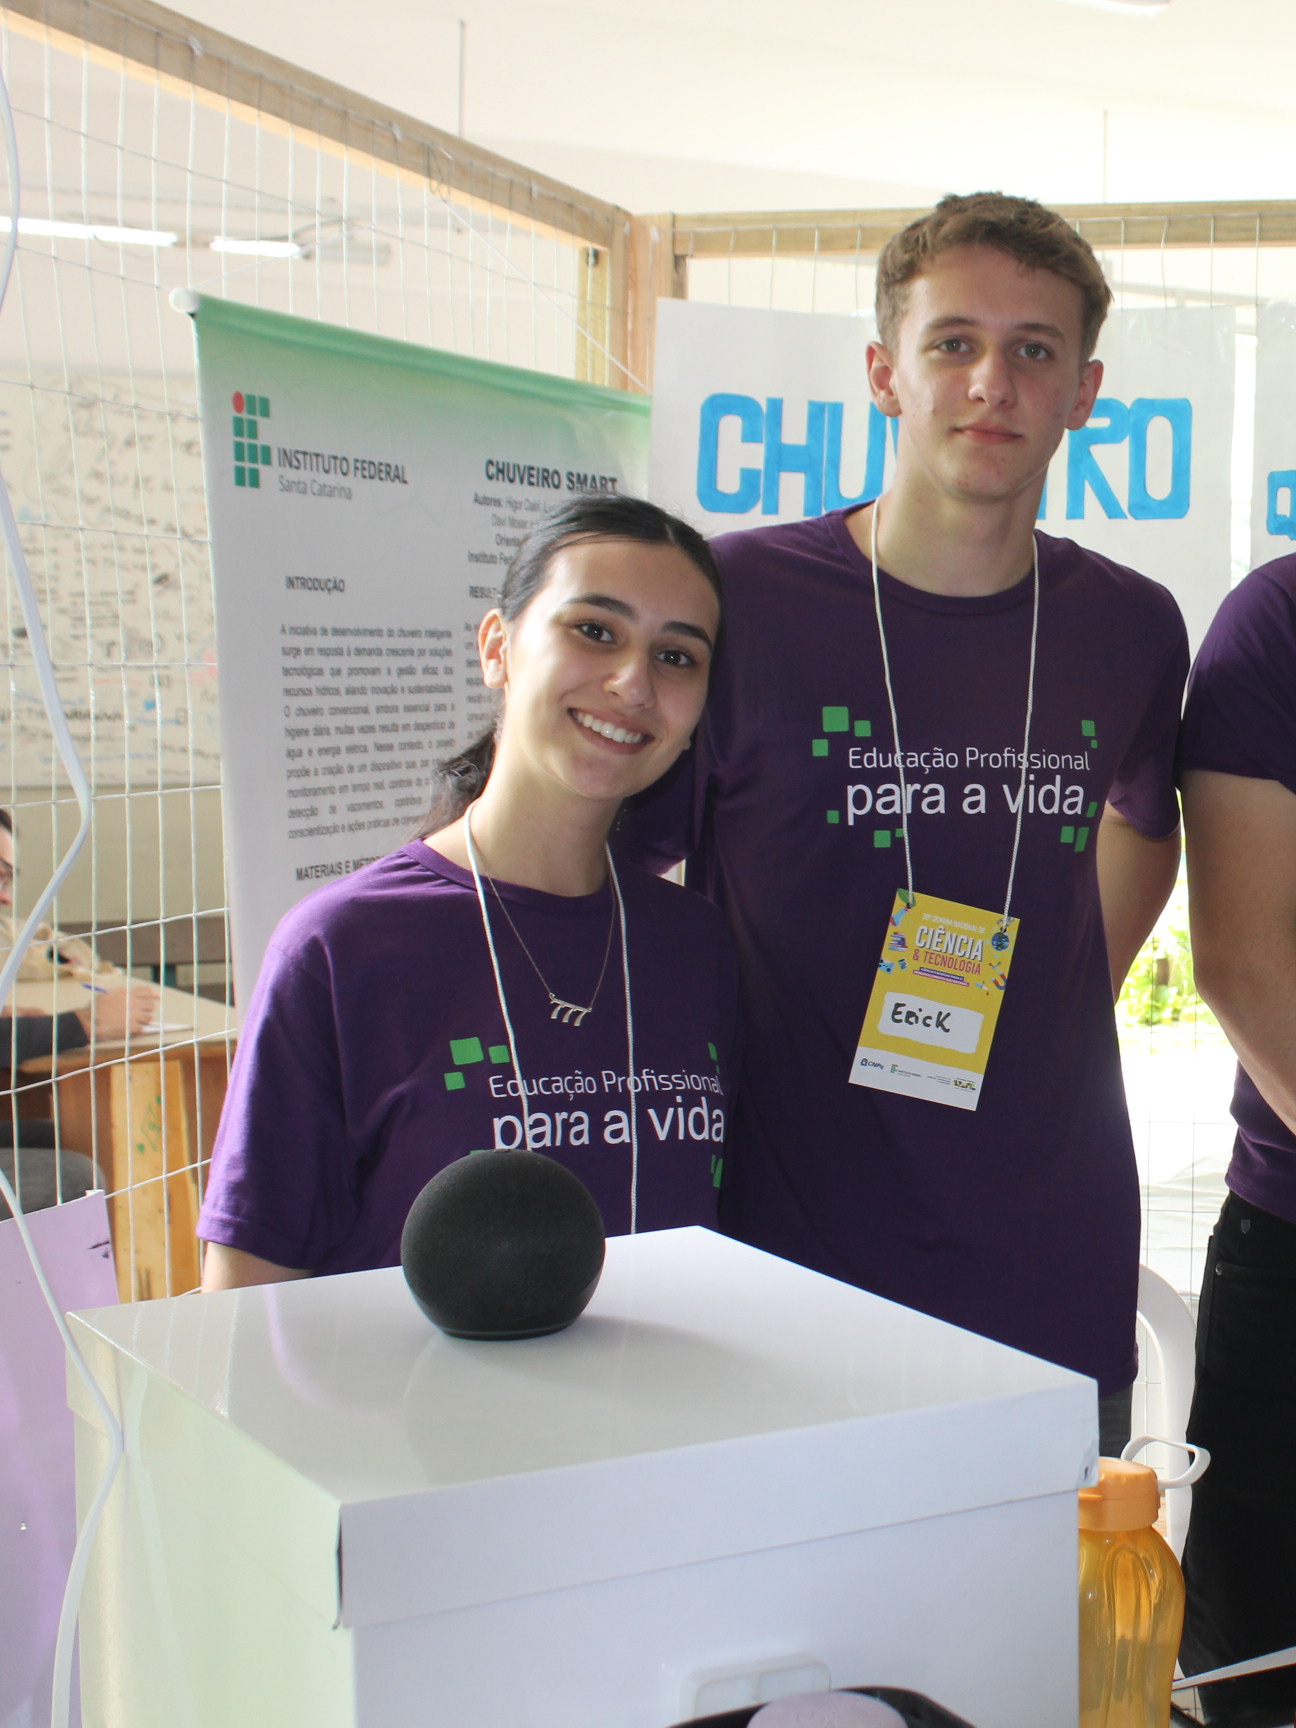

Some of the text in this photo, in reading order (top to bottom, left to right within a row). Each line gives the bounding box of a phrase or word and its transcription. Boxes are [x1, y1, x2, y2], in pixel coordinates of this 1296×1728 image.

[278, 448, 408, 484] INSTITUTO FEDERAL
[696, 392, 1192, 520] CHURO
[279, 475, 352, 500] Santa Catarina
[485, 459, 617, 492] CHUVEIRO SMART
[473, 491, 502, 506] Autores:
[468, 551, 497, 564] Instituto
[286, 576, 345, 594] INTRODUÇÃO
[280, 624, 286, 635] A
[320, 625, 328, 636] de
[284, 705, 290, 717] O
[849, 747, 1090, 774] Educação Profissional
[847, 774, 1084, 826] para a vida
[296, 862, 342, 880] MATERIAIS
[345, 861, 350, 873] E
[916, 925, 983, 962] CIÊNCIA
[913, 948, 919, 961] &
[923, 951, 981, 975] TECNOLOGIA
[489, 1068, 724, 1100] Educação Profissional
[492, 1096, 724, 1150] para a vida
